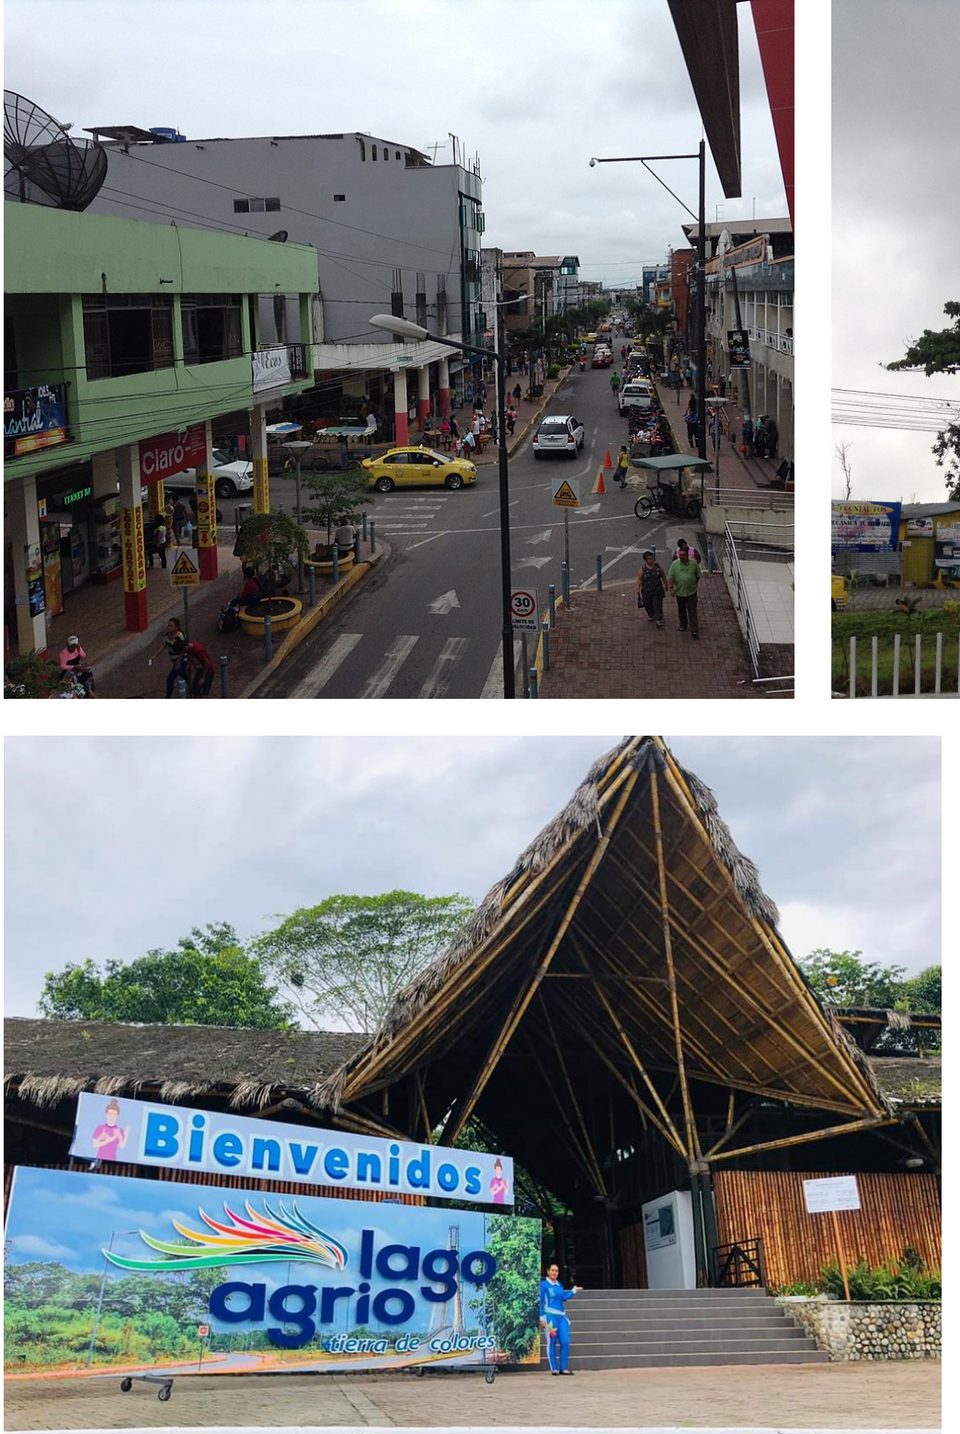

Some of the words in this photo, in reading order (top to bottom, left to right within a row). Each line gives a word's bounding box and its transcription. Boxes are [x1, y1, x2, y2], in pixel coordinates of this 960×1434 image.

[142, 445, 184, 475] Claro
[135, 506, 145, 568] RECARGAS
[514, 597, 530, 608] 30
[143, 1112, 483, 1195] Bienvenidos
[360, 1229, 497, 1302] lago
[209, 1281, 416, 1349] agrio
[329, 1334, 387, 1353] tierra
[396, 1334, 420, 1352] de
[429, 1334, 496, 1353] colores
